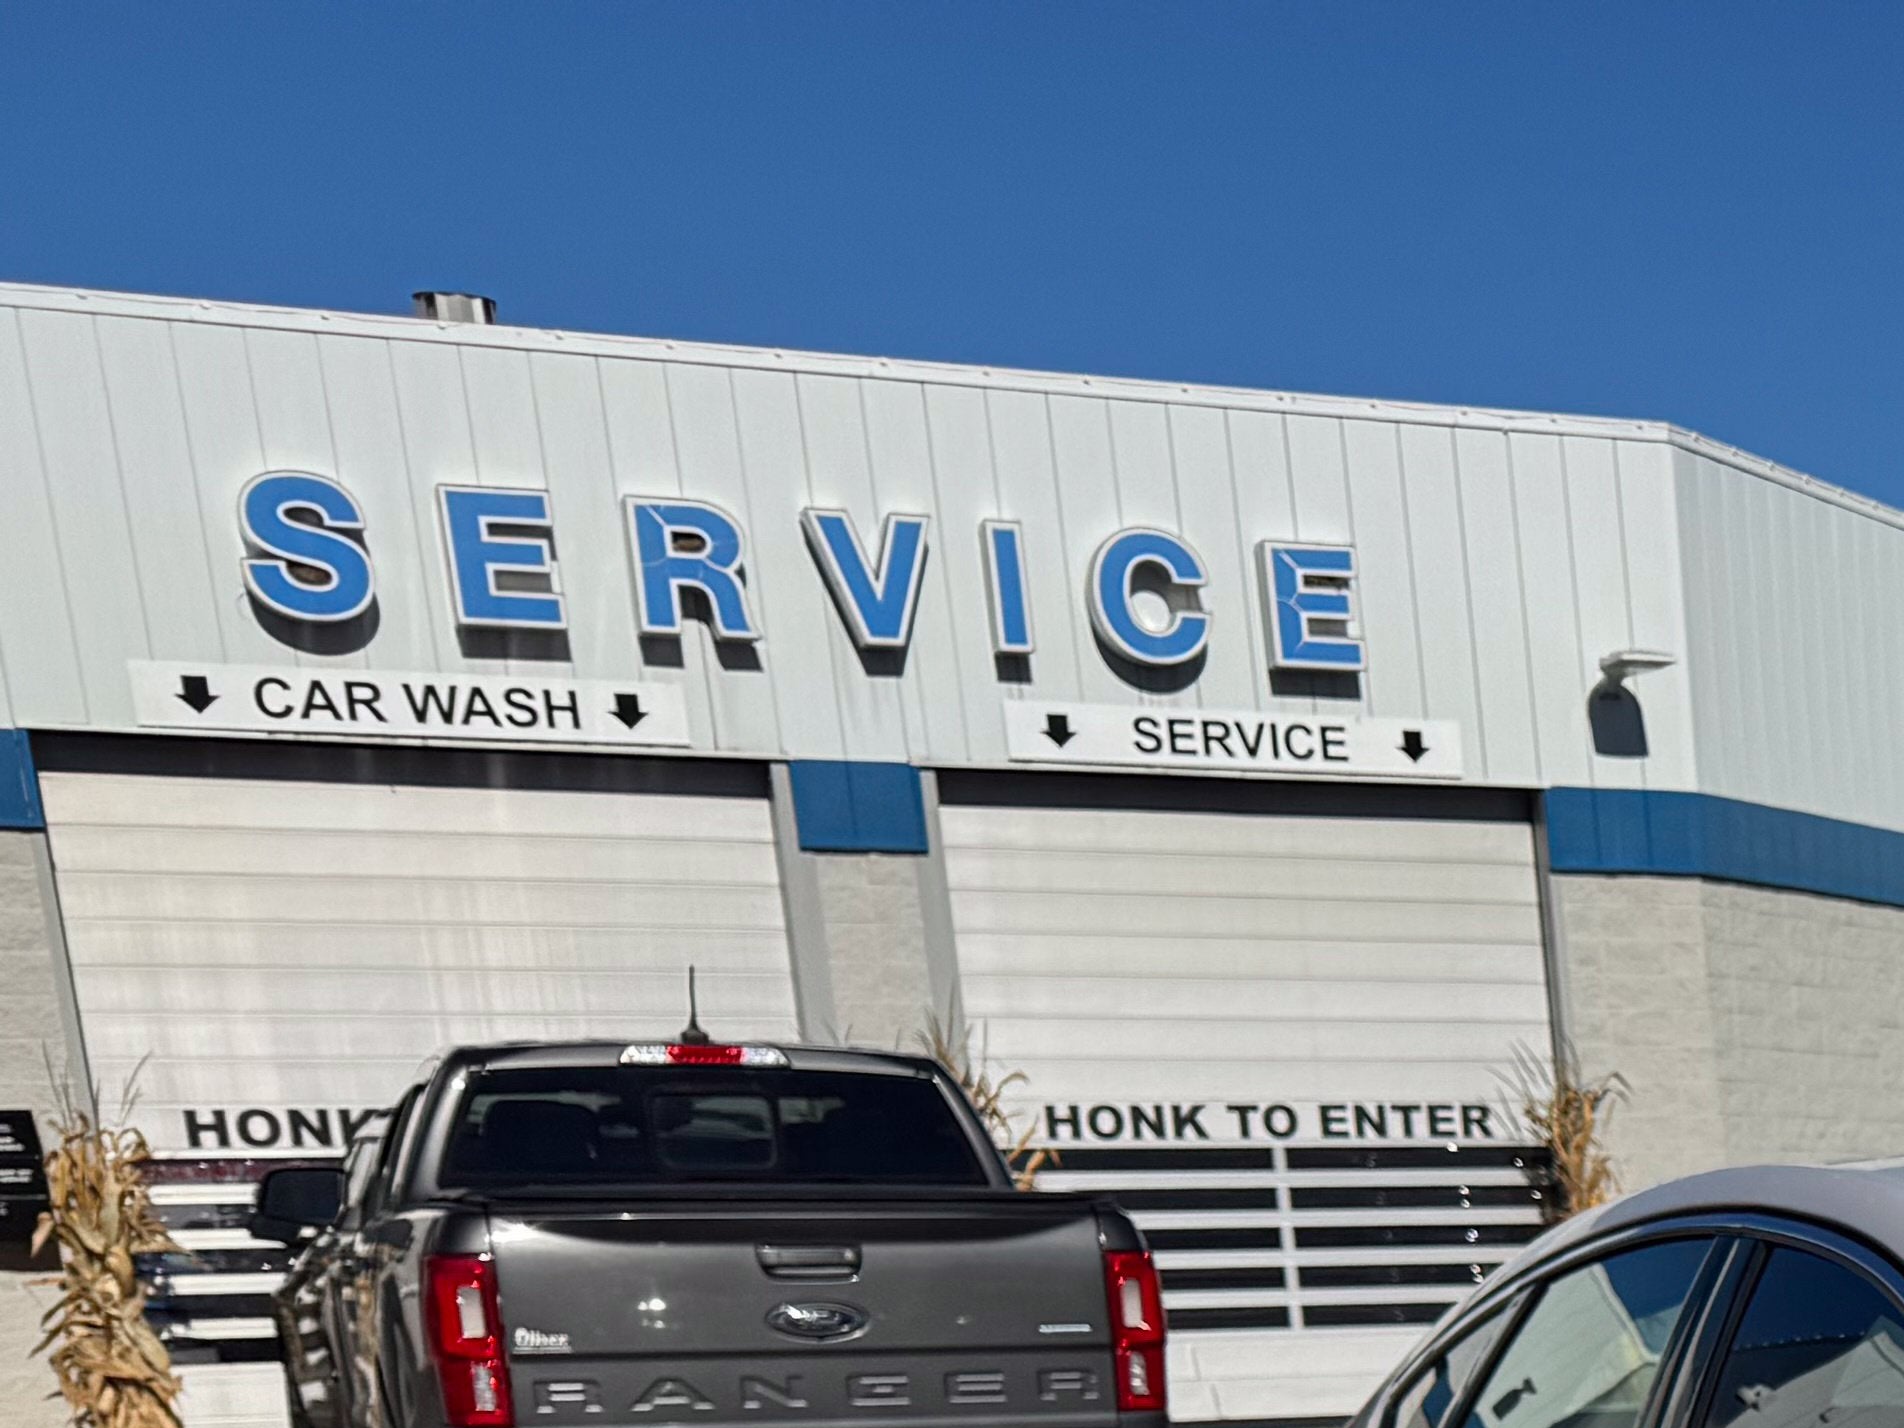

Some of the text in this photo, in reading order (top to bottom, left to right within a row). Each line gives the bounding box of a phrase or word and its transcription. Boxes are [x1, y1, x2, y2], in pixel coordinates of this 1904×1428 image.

[238, 468, 1367, 673] SERVICE
[253, 677, 582, 730] CAR WASH
[1132, 717, 1350, 763] SERVICE
[1044, 1104, 1496, 1140] HONK TO ENTER
[533, 1371, 1100, 1413] RANGER
